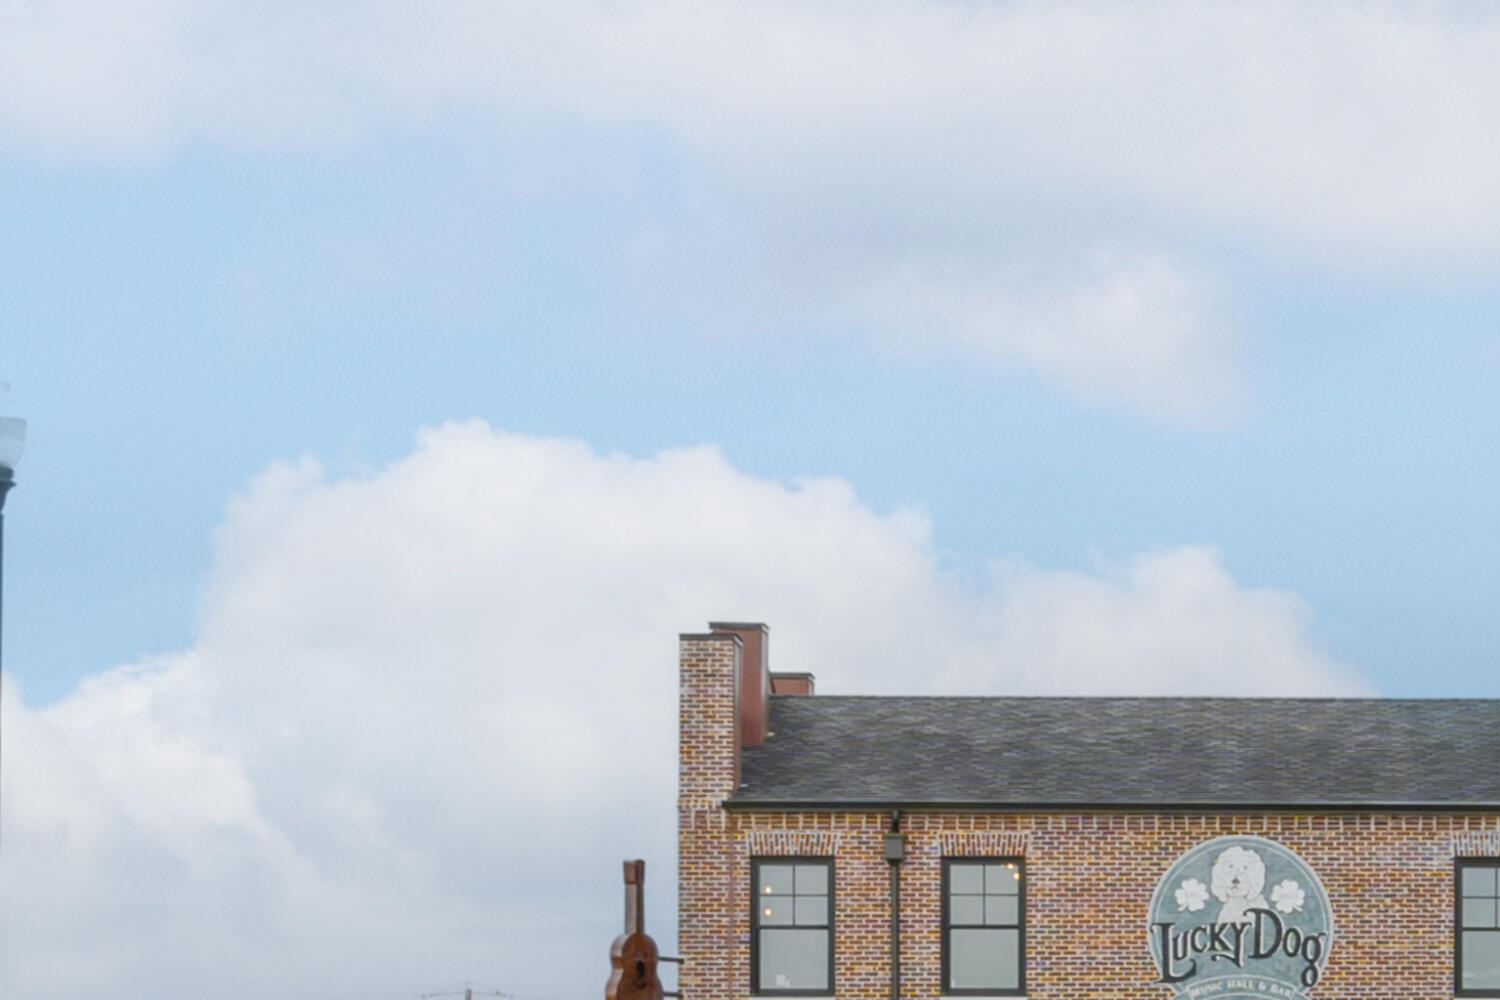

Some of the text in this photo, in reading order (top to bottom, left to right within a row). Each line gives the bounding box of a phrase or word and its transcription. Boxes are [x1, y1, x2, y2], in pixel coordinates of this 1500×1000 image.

[1190, 979, 1292, 998] MUSIC HALL & BAR
